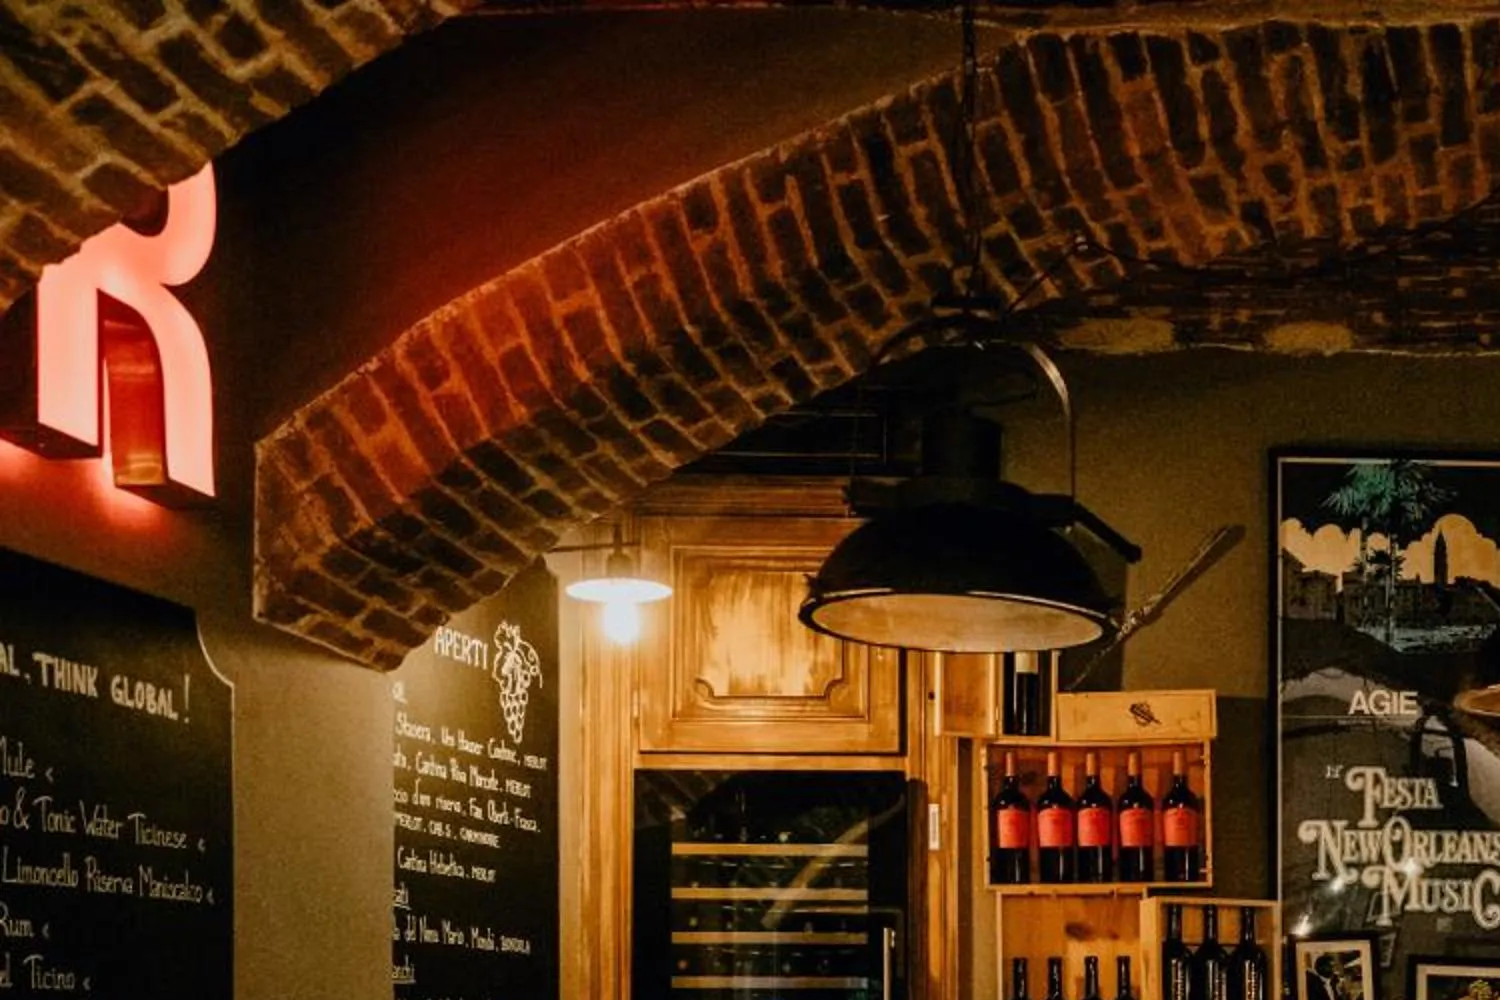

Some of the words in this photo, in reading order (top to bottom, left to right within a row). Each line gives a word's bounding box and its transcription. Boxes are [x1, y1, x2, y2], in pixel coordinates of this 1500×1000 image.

[37, 160, 216, 497] R
[434, 626, 489, 670] APERTI
[31, 651, 99, 698] THINK
[1347, 689, 1419, 716] AGIE
[13, 786, 30, 831] &
[32, 795, 77, 834] Tonic
[78, 799, 125, 840] Water
[127, 812, 188, 849] Ticinese
[1345, 765, 1445, 829] FESTA
[1, 845, 80, 888] Limoncello
[84, 855, 134, 895] Riserva
[1297, 819, 1386, 886] NEW
[22, 954, 76, 990] Ticino
